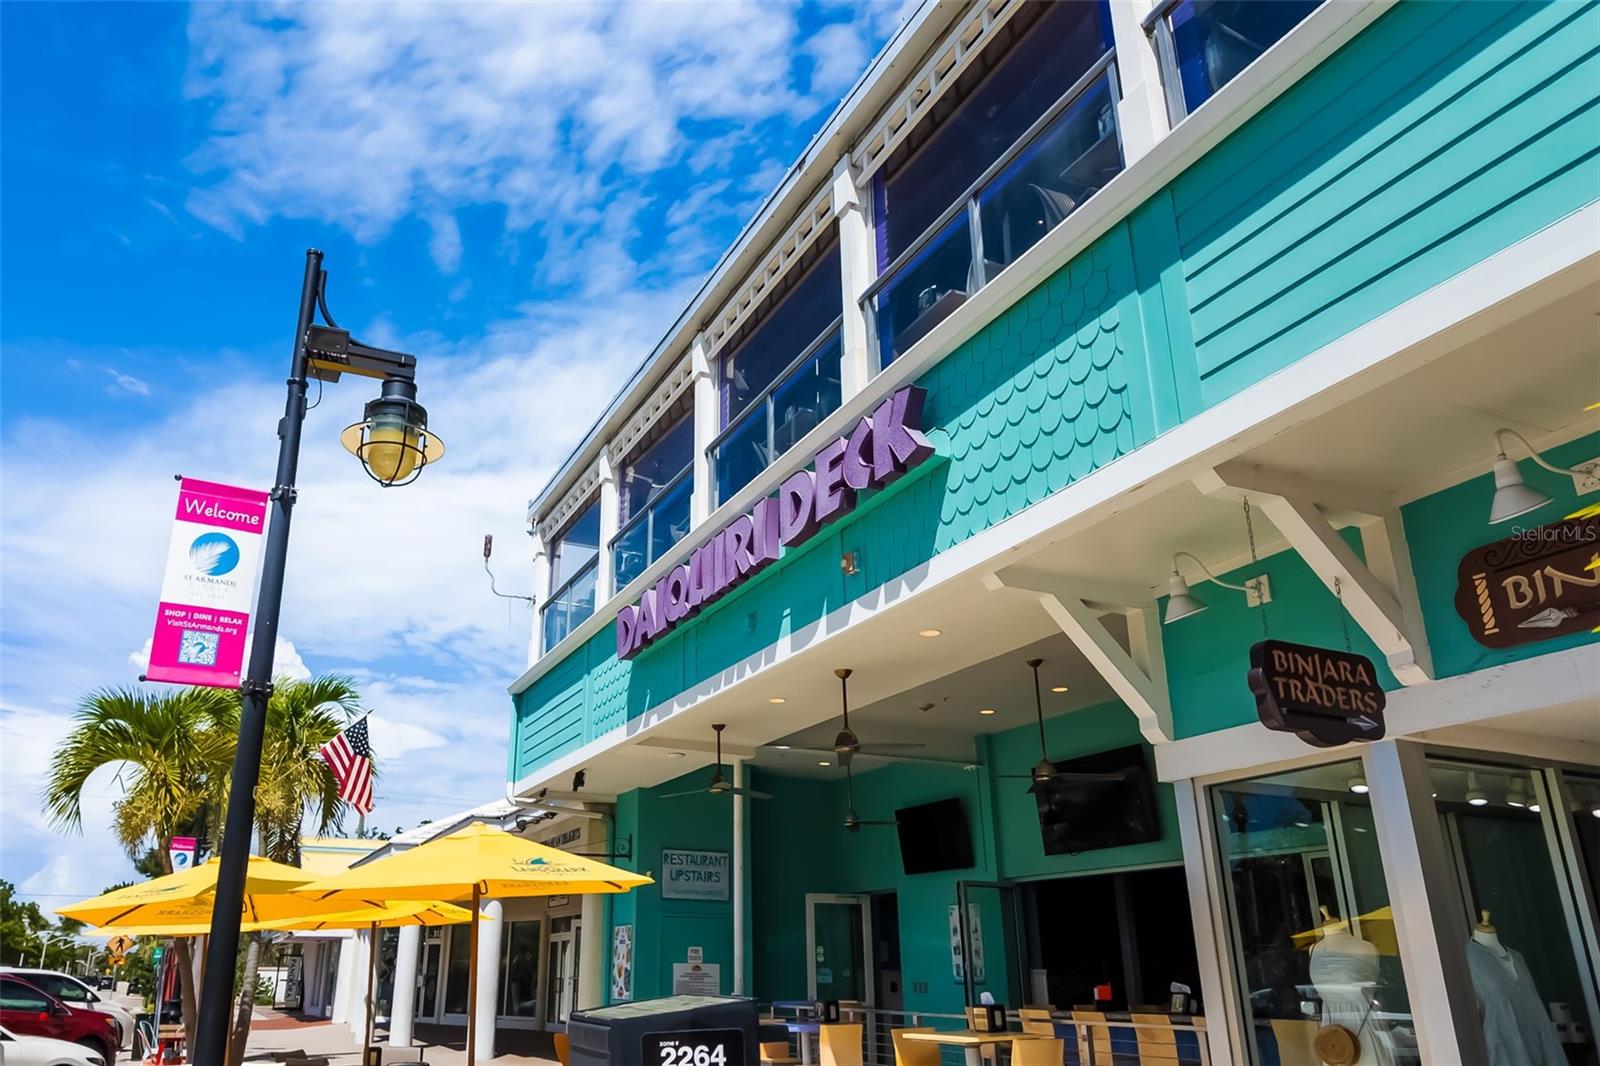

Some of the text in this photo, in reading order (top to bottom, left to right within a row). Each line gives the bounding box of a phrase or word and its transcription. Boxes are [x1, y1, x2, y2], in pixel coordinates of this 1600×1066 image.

[184, 497, 260, 525] Welcome
[616, 383, 935, 660] DAIQUIRI DECK
[194, 577, 237, 587] ARMANDS
[164, 609, 244, 626] SHOP DINE RELAX
[167, 619, 238, 636] VisitStArmands.org
[1271, 648, 1372, 687] BINJARA
[1272, 676, 1378, 714] TRADERS
[663, 853, 729, 867] RESTAURANT
[670, 869, 722, 884] UPSTAIRS
[660, 1044, 727, 1066] 2264
